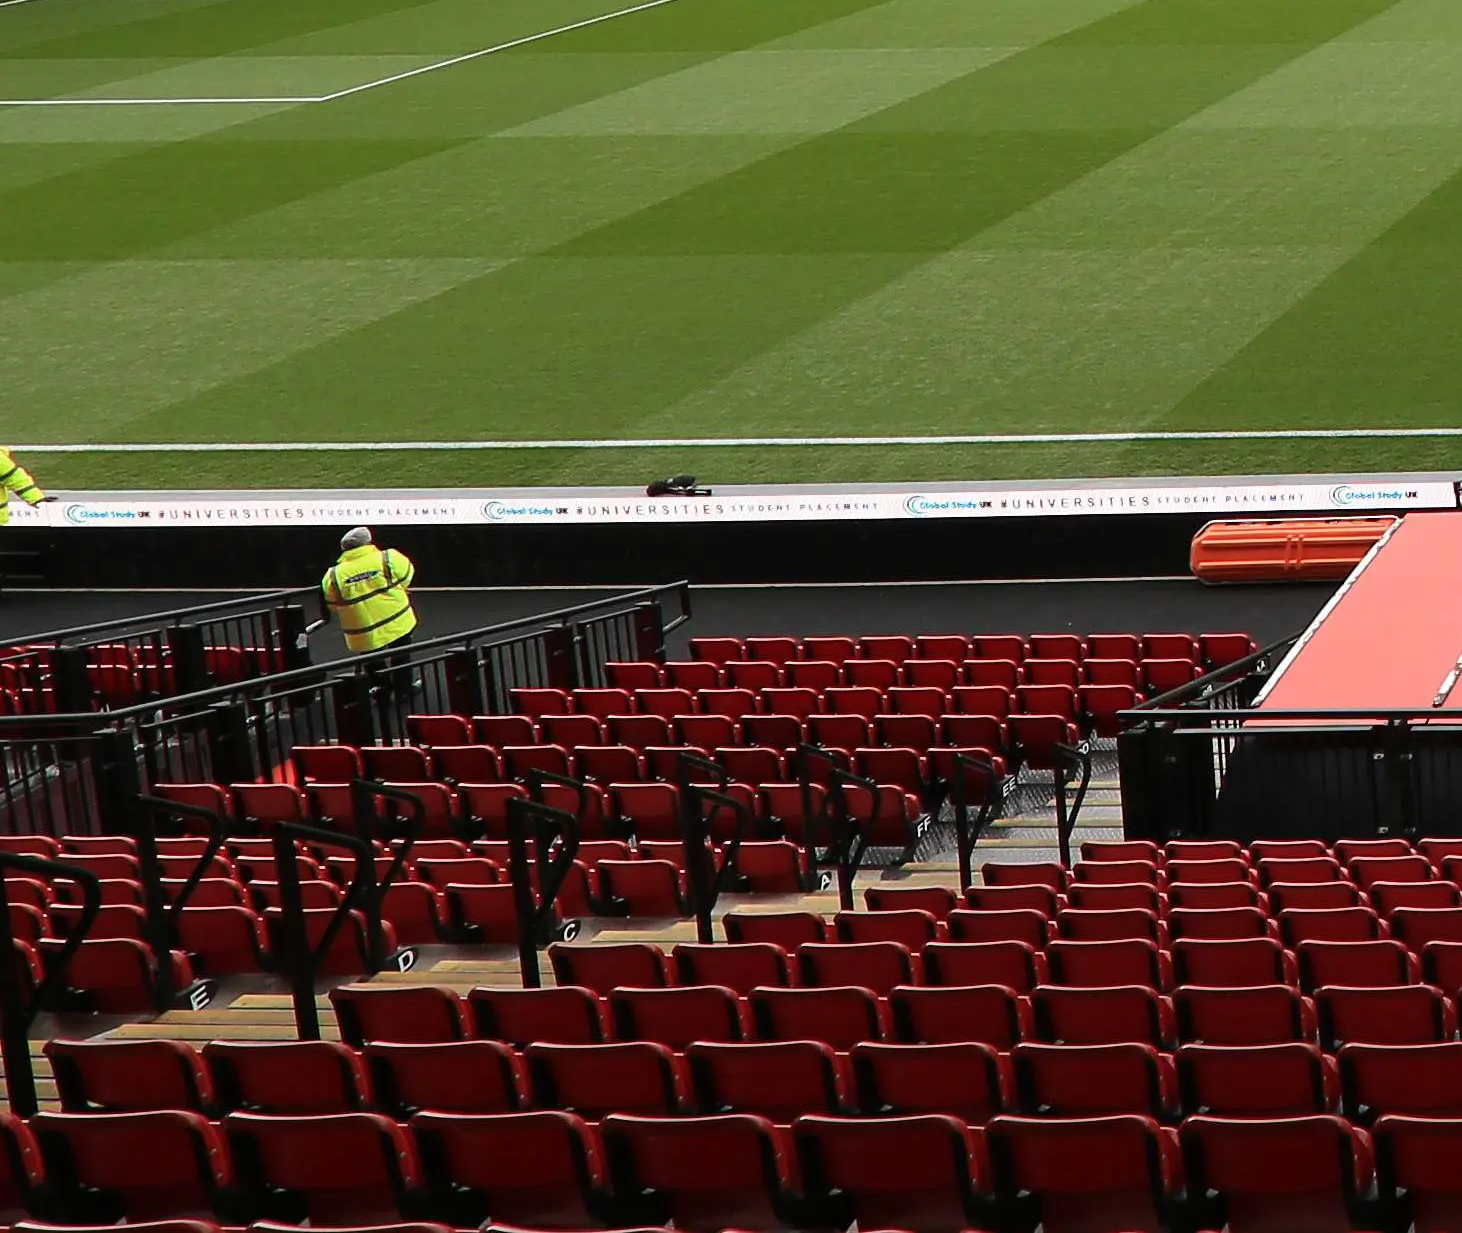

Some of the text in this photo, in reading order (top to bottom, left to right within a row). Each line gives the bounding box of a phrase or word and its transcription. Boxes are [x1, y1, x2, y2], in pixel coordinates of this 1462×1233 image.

[576, 504, 724, 516] #UNIVERSITIES
[731, 503, 791, 512] STUDENT
[799, 502, 878, 511] PLACEMENT
[1000, 496, 1150, 509] #UNIVERSITIES
[1157, 496, 1216, 504] STUDENT
[1225, 494, 1304, 503] PLACEMENT
[158, 508, 304, 520] #UNIVERSITIES
[311, 509, 371, 517] STUDENT
[378, 508, 456, 517] PLACEMENT
[1002, 776, 1016, 798] EE
[917, 814, 931, 838] FF
[563, 923, 576, 942] C
[397, 948, 415, 973] D
[189, 984, 210, 1011] E
